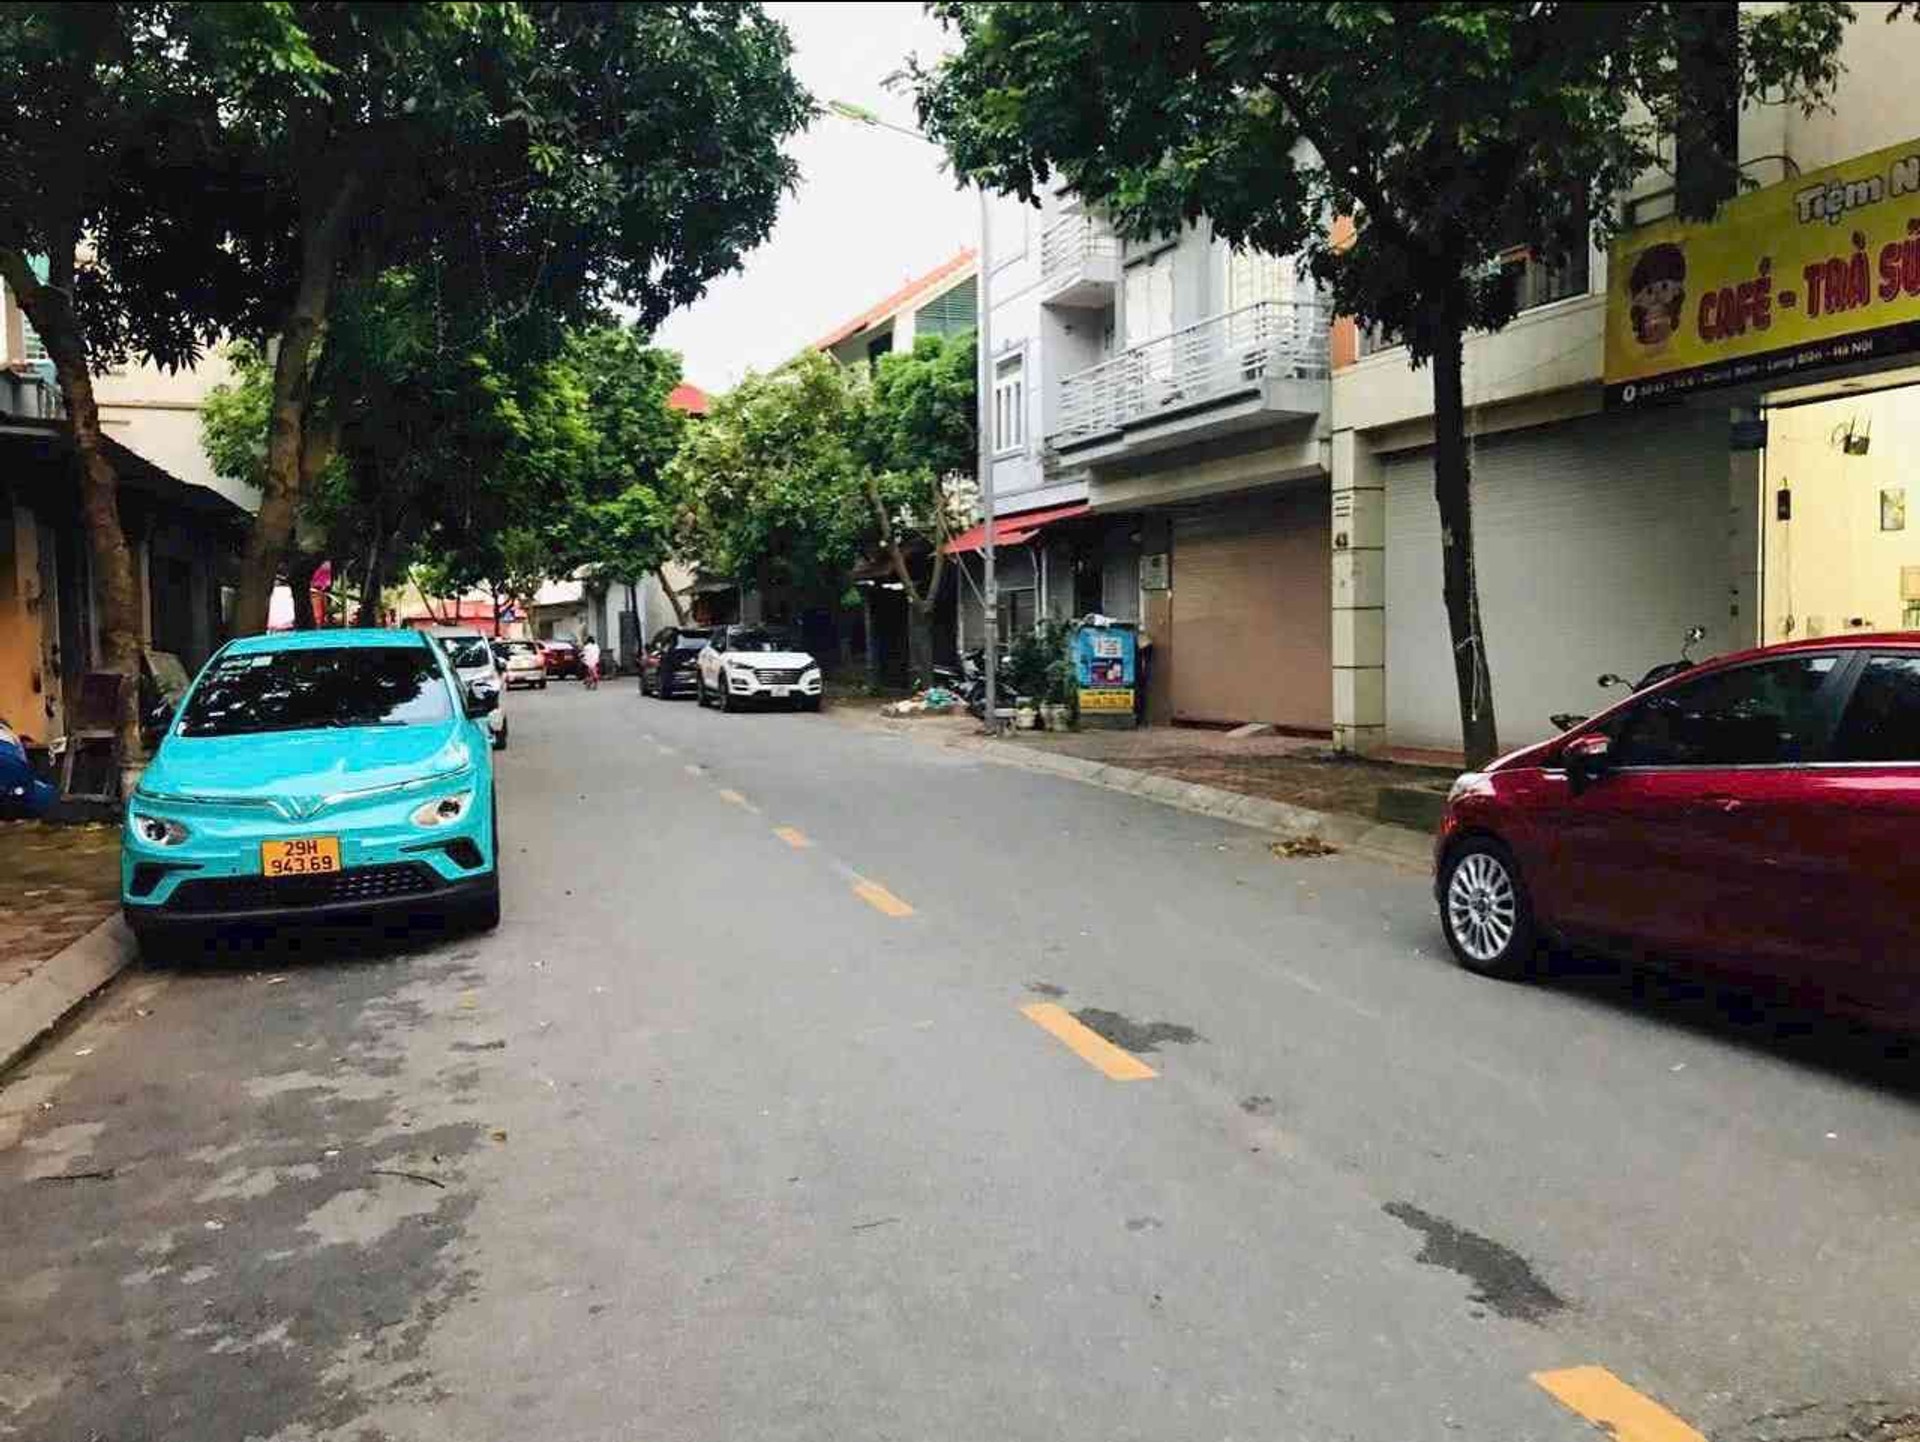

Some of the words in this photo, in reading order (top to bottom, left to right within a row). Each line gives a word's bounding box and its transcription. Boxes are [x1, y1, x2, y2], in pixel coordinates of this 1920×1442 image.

[1795, 174, 1884, 227] Tiệm
[1698, 256, 1773, 343] CAFÉ
[1803, 230, 1871, 319] TRÀ
[284, 840, 319, 856] 29H
